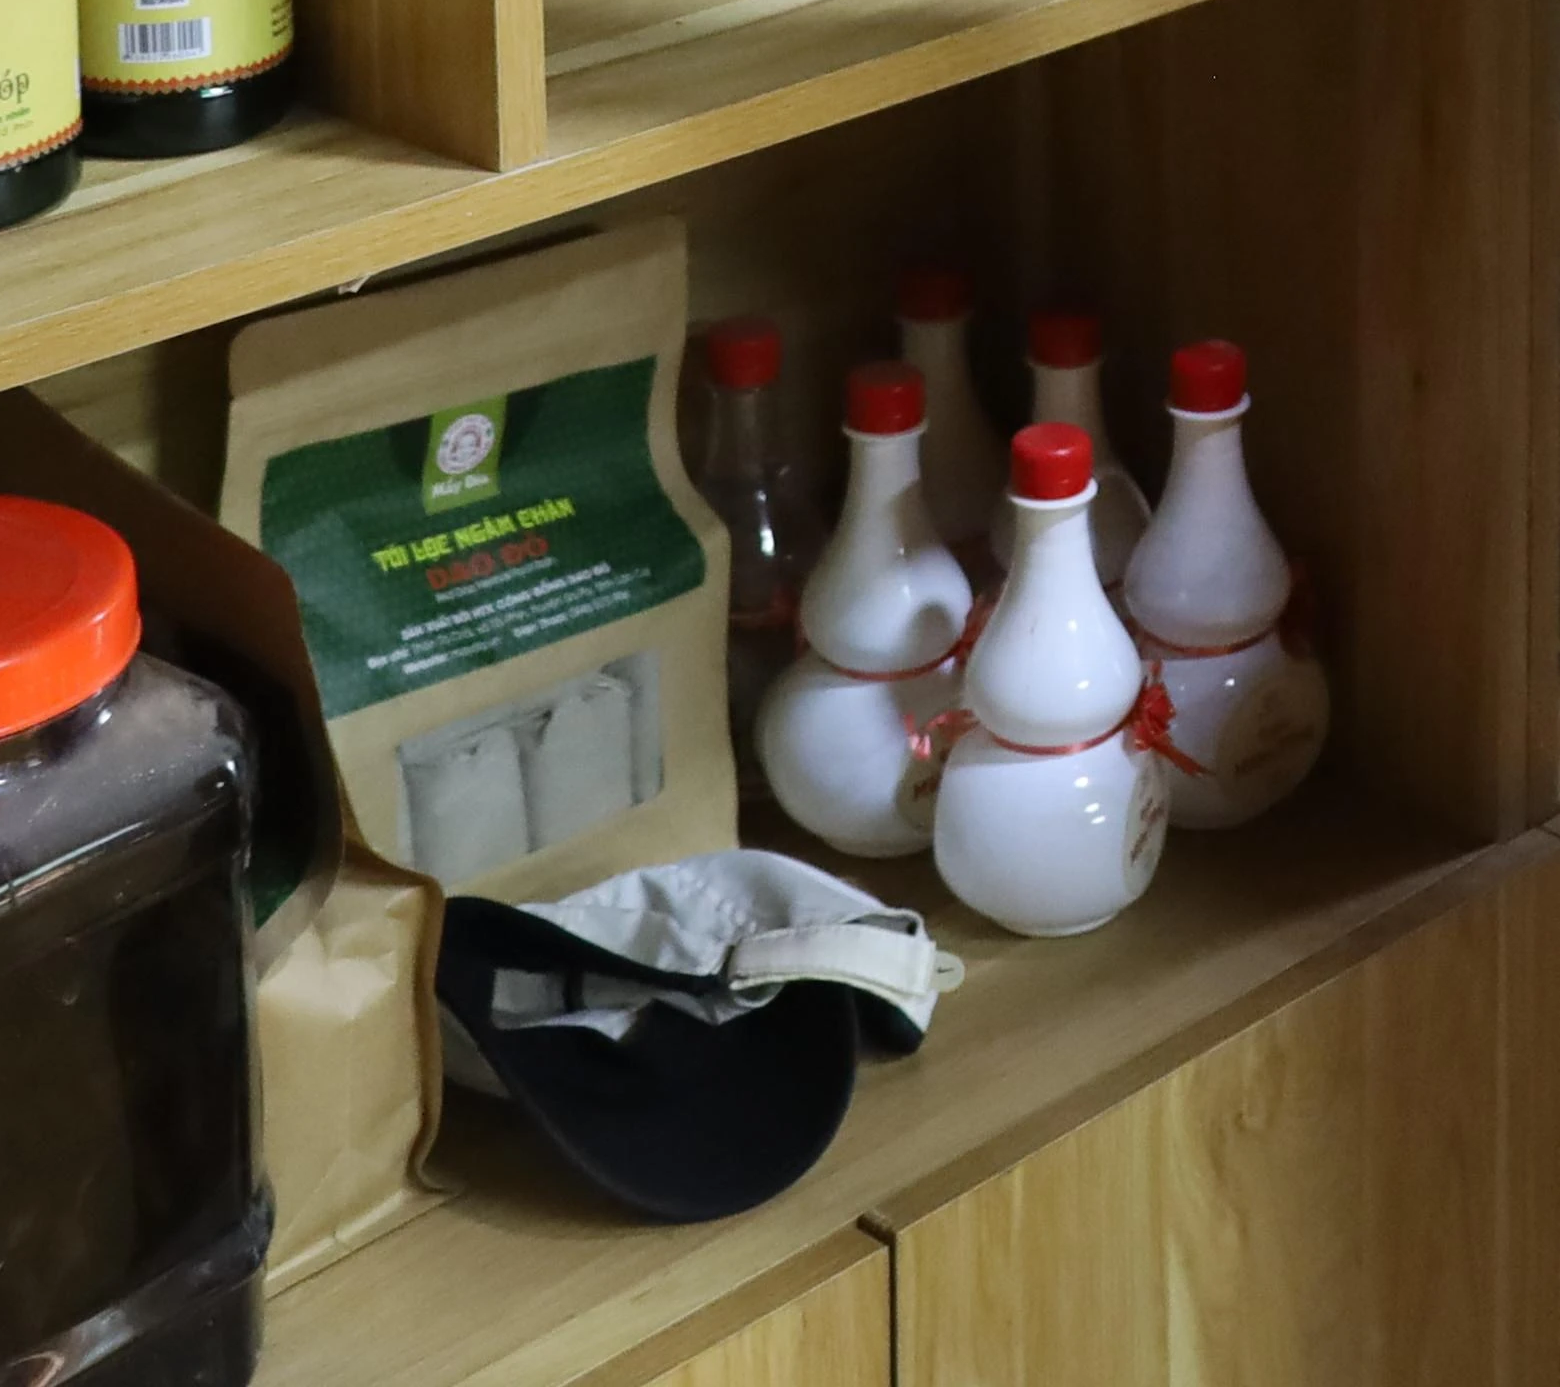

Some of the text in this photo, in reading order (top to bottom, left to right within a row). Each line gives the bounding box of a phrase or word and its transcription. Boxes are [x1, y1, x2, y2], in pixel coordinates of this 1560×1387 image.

[370, 495, 578, 573] TÚI LỌC NGÂM CHÂN
[425, 550, 496, 592] DAO
